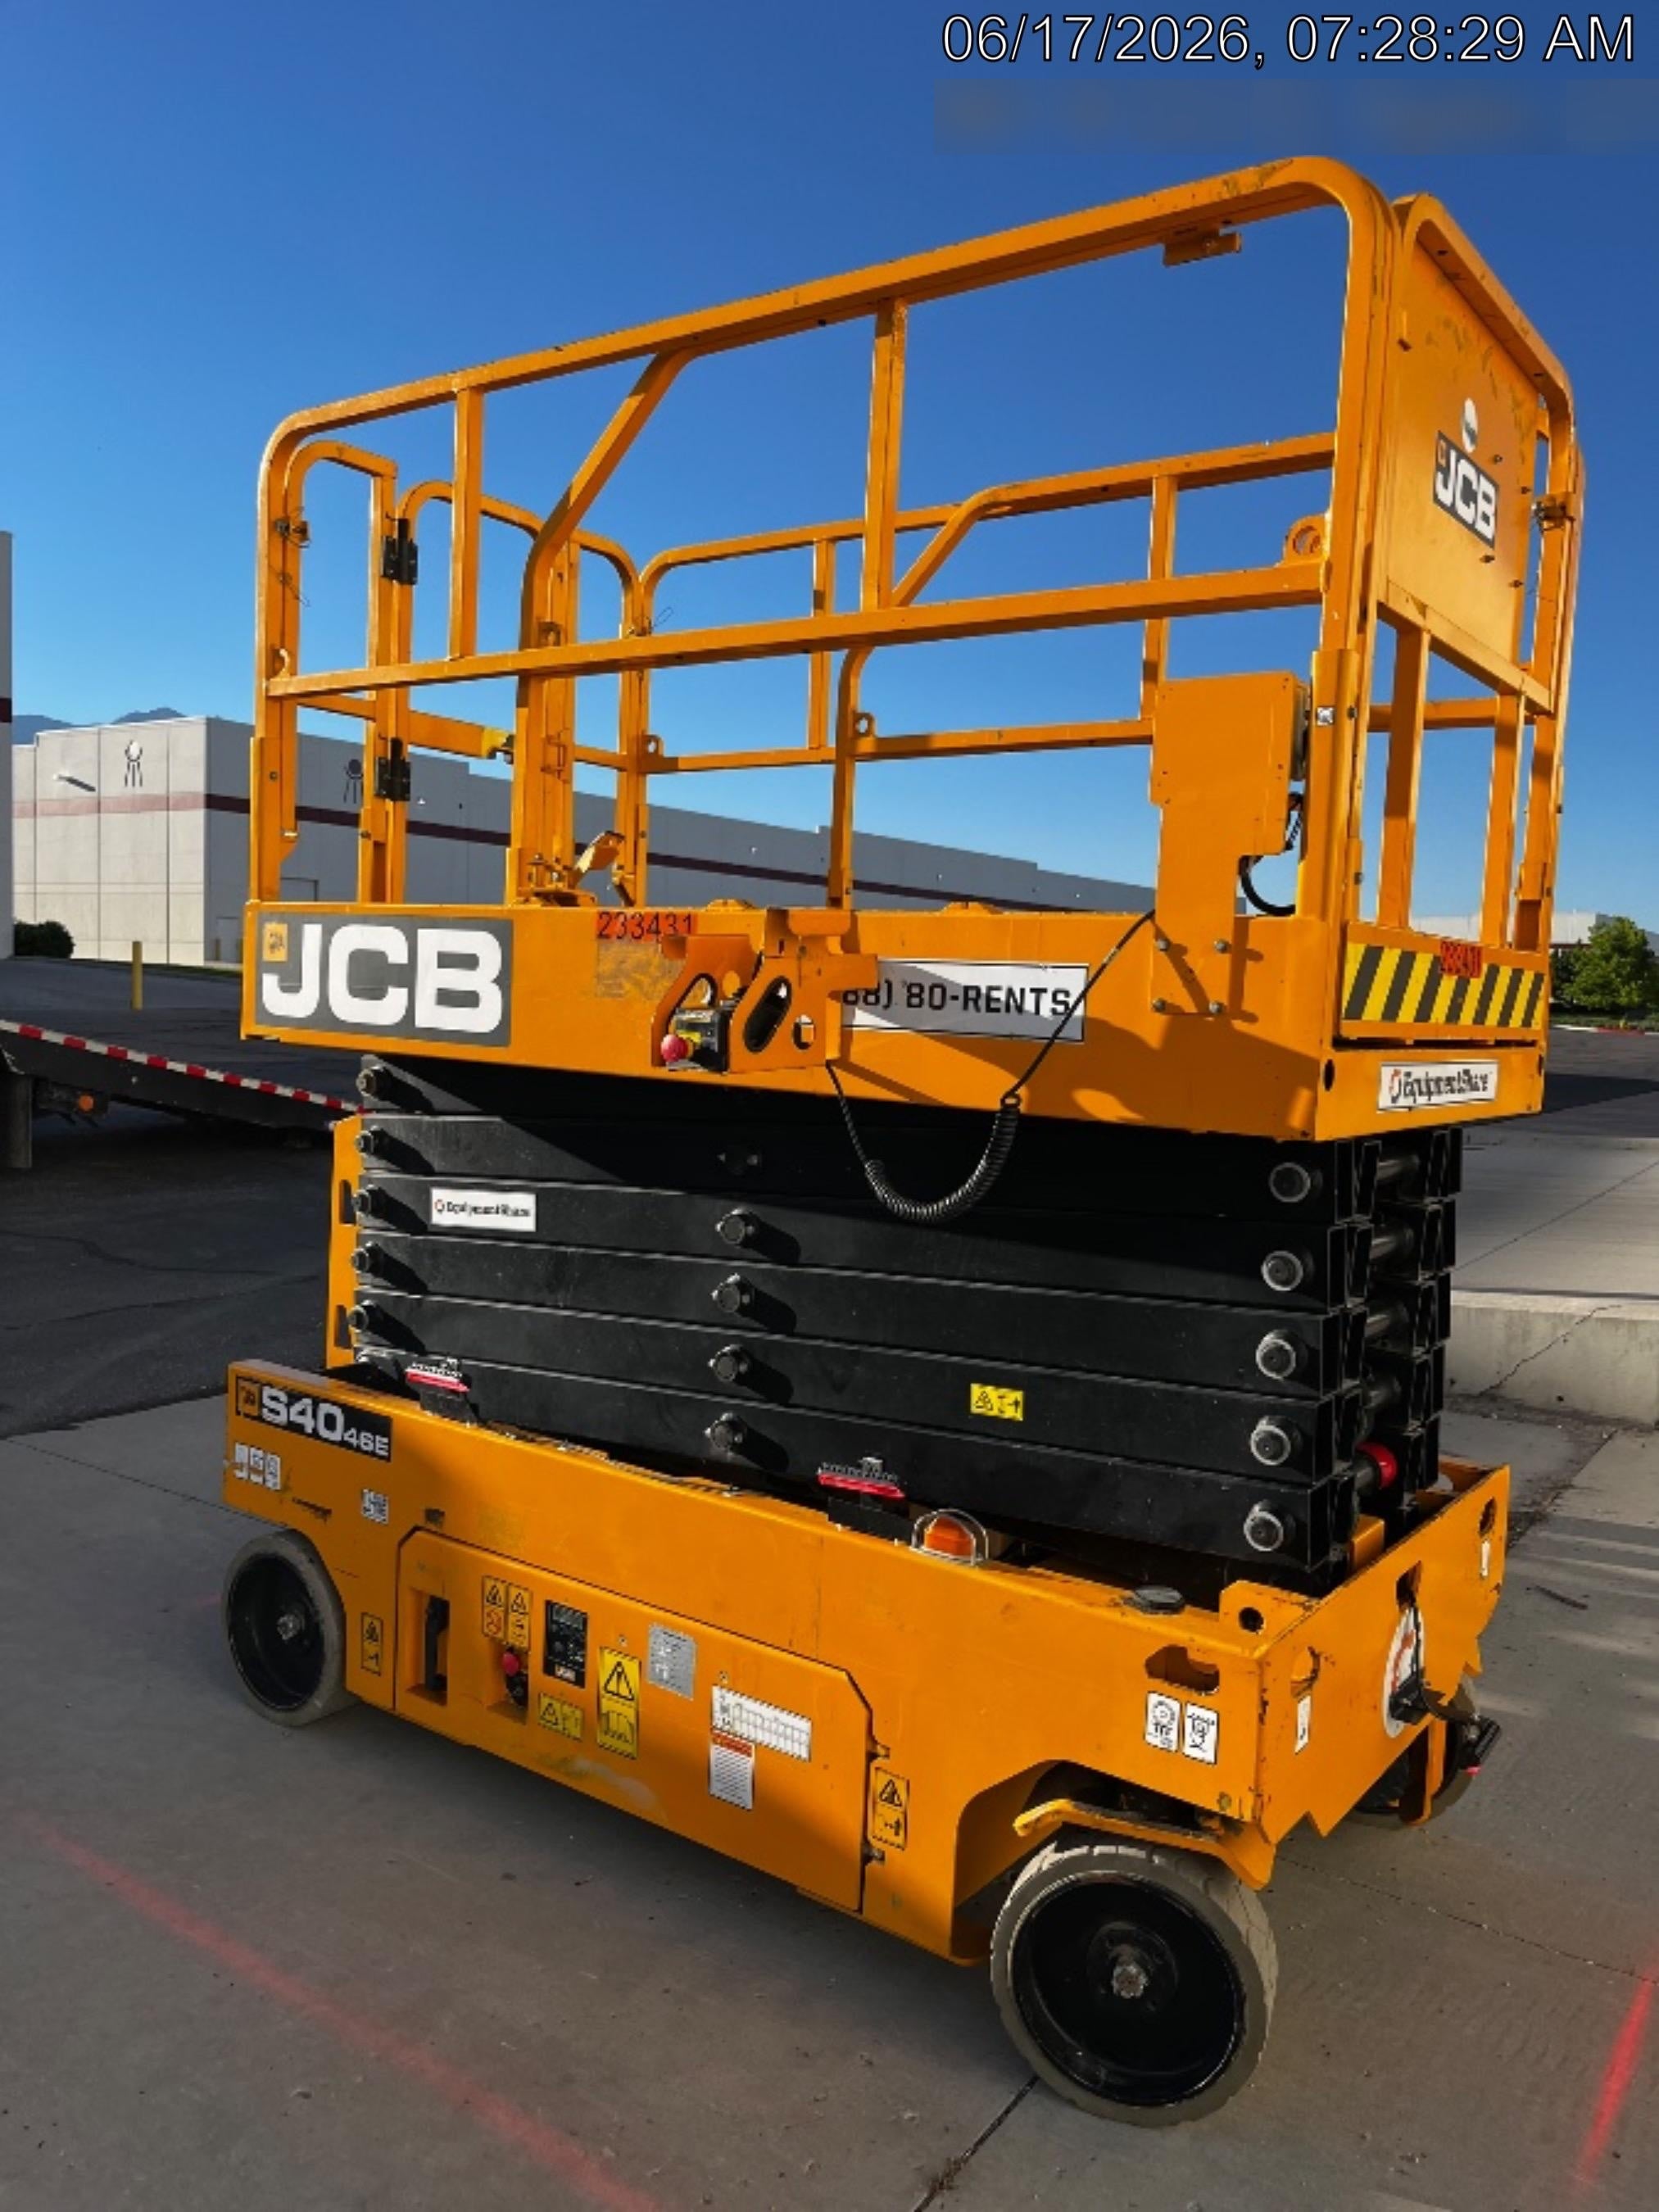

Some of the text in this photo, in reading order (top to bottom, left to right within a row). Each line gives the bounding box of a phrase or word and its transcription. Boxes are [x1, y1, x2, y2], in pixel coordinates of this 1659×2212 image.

[1435, 448, 1496, 542] JCB
[599, 911, 692, 940] 233431
[262, 923, 502, 1033] JCB
[904, 982, 1071, 1016] 80-RENTS
[262, 1385, 345, 1442] S40
[344, 1427, 389, 1457] 46E
